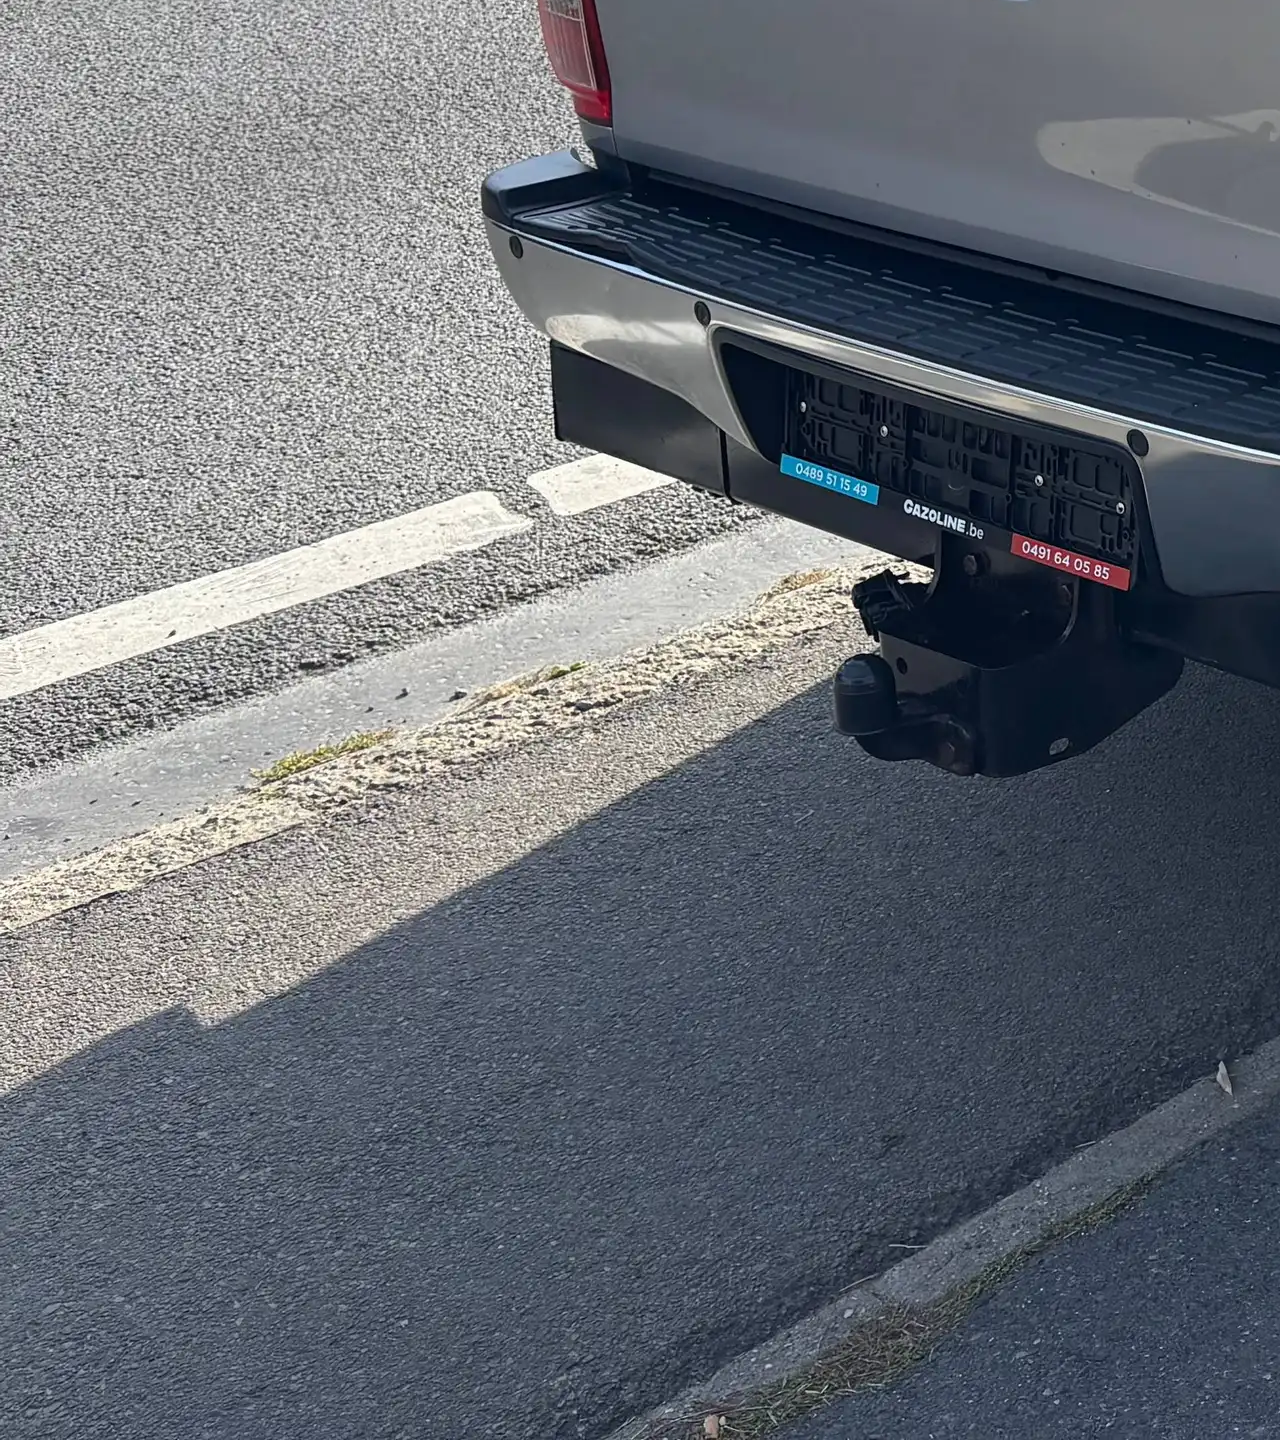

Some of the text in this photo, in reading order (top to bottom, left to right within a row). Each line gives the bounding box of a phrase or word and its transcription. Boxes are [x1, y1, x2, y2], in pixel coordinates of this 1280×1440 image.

[795, 462, 868, 497] 0489 51 15 49
[903, 498, 985, 540] GAZOLINE.be
[1021, 541, 1111, 580] 0491 64 05 85
